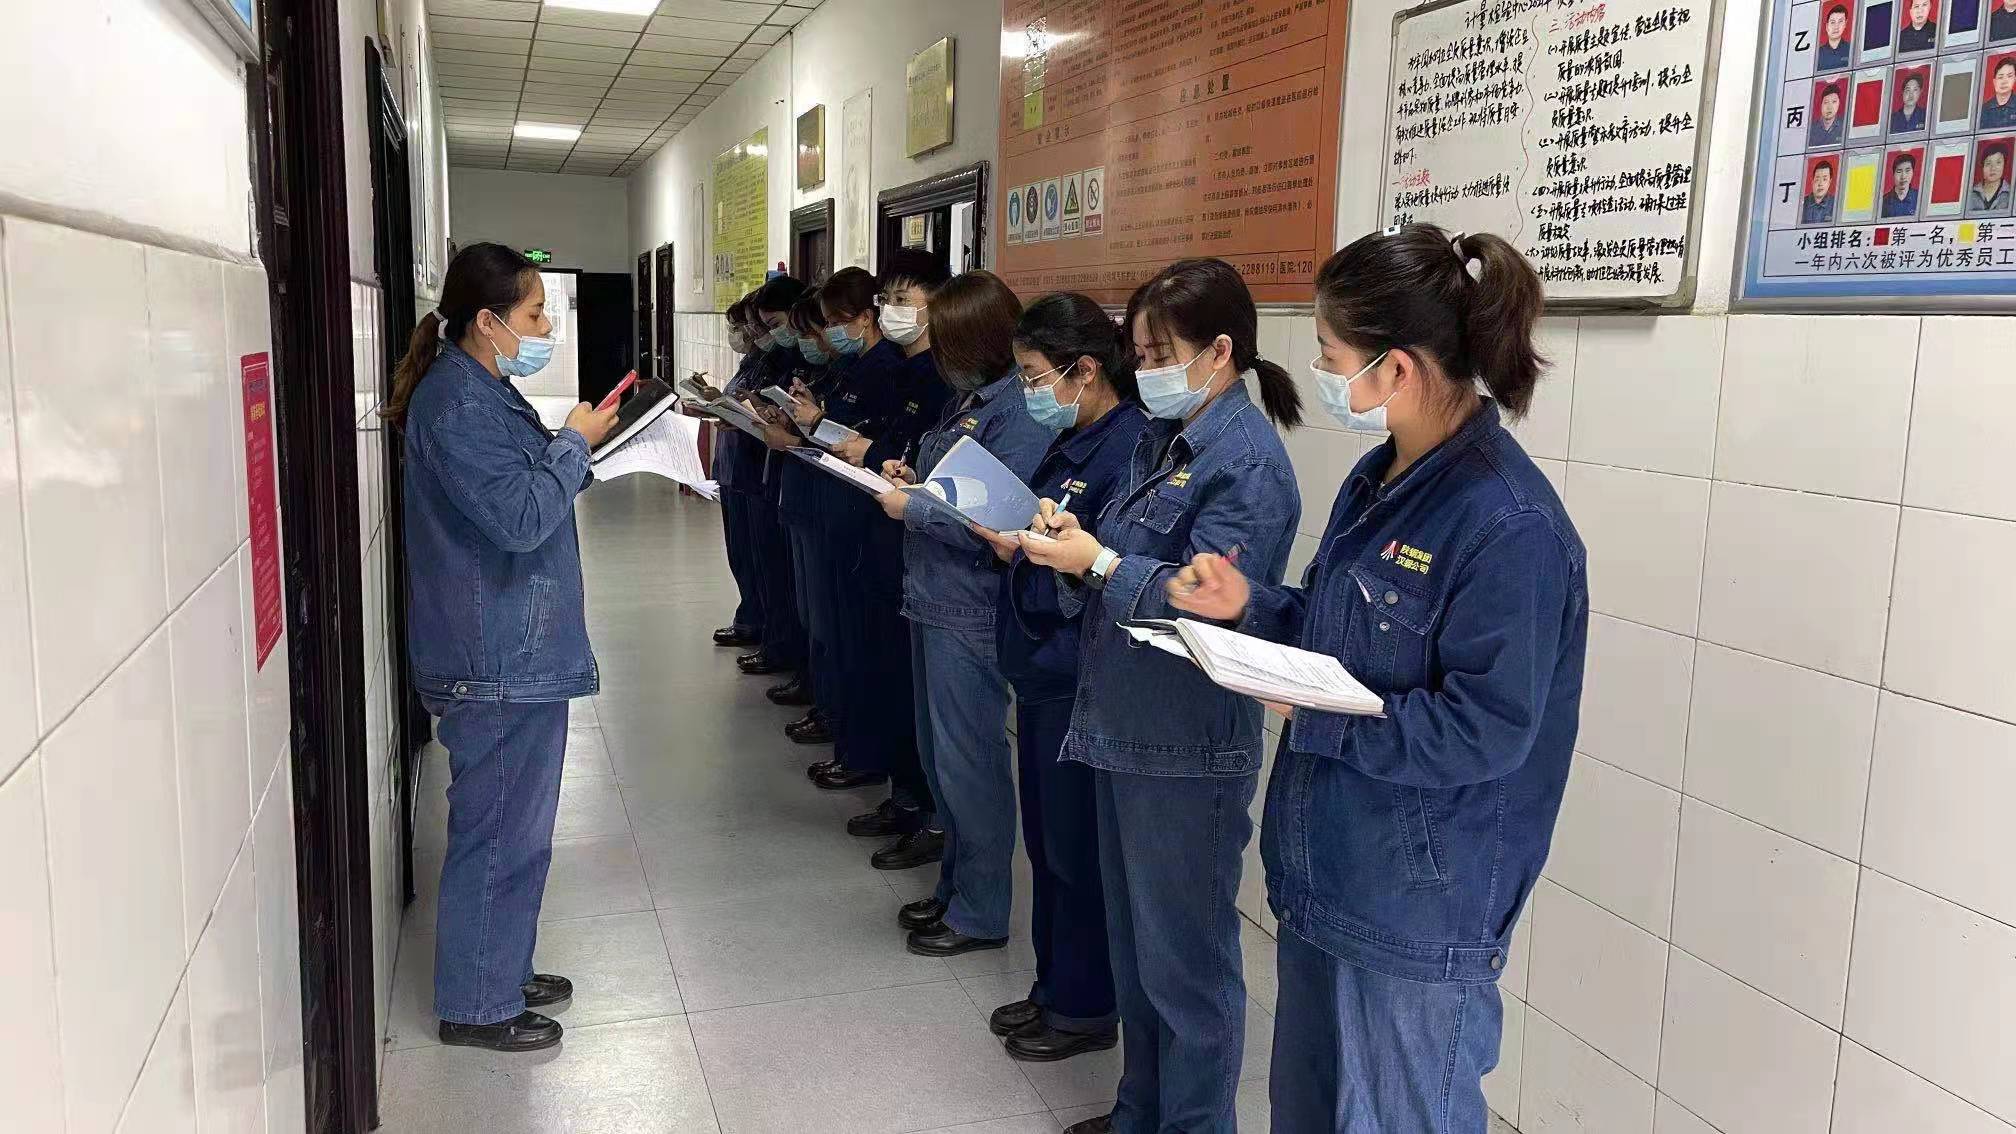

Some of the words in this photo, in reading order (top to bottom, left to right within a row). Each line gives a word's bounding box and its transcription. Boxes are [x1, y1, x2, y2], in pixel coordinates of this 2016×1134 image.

[1794, 31, 1811, 52] 乙
[1786, 105, 1805, 128] 丙
[1779, 182, 1796, 203] 丁
[1976, 223, 2015, 243] 第二
[1232, 262, 1275, 277] -2288119
[1795, 248, 2014, 271] 一年内六次被评为优秀员工
